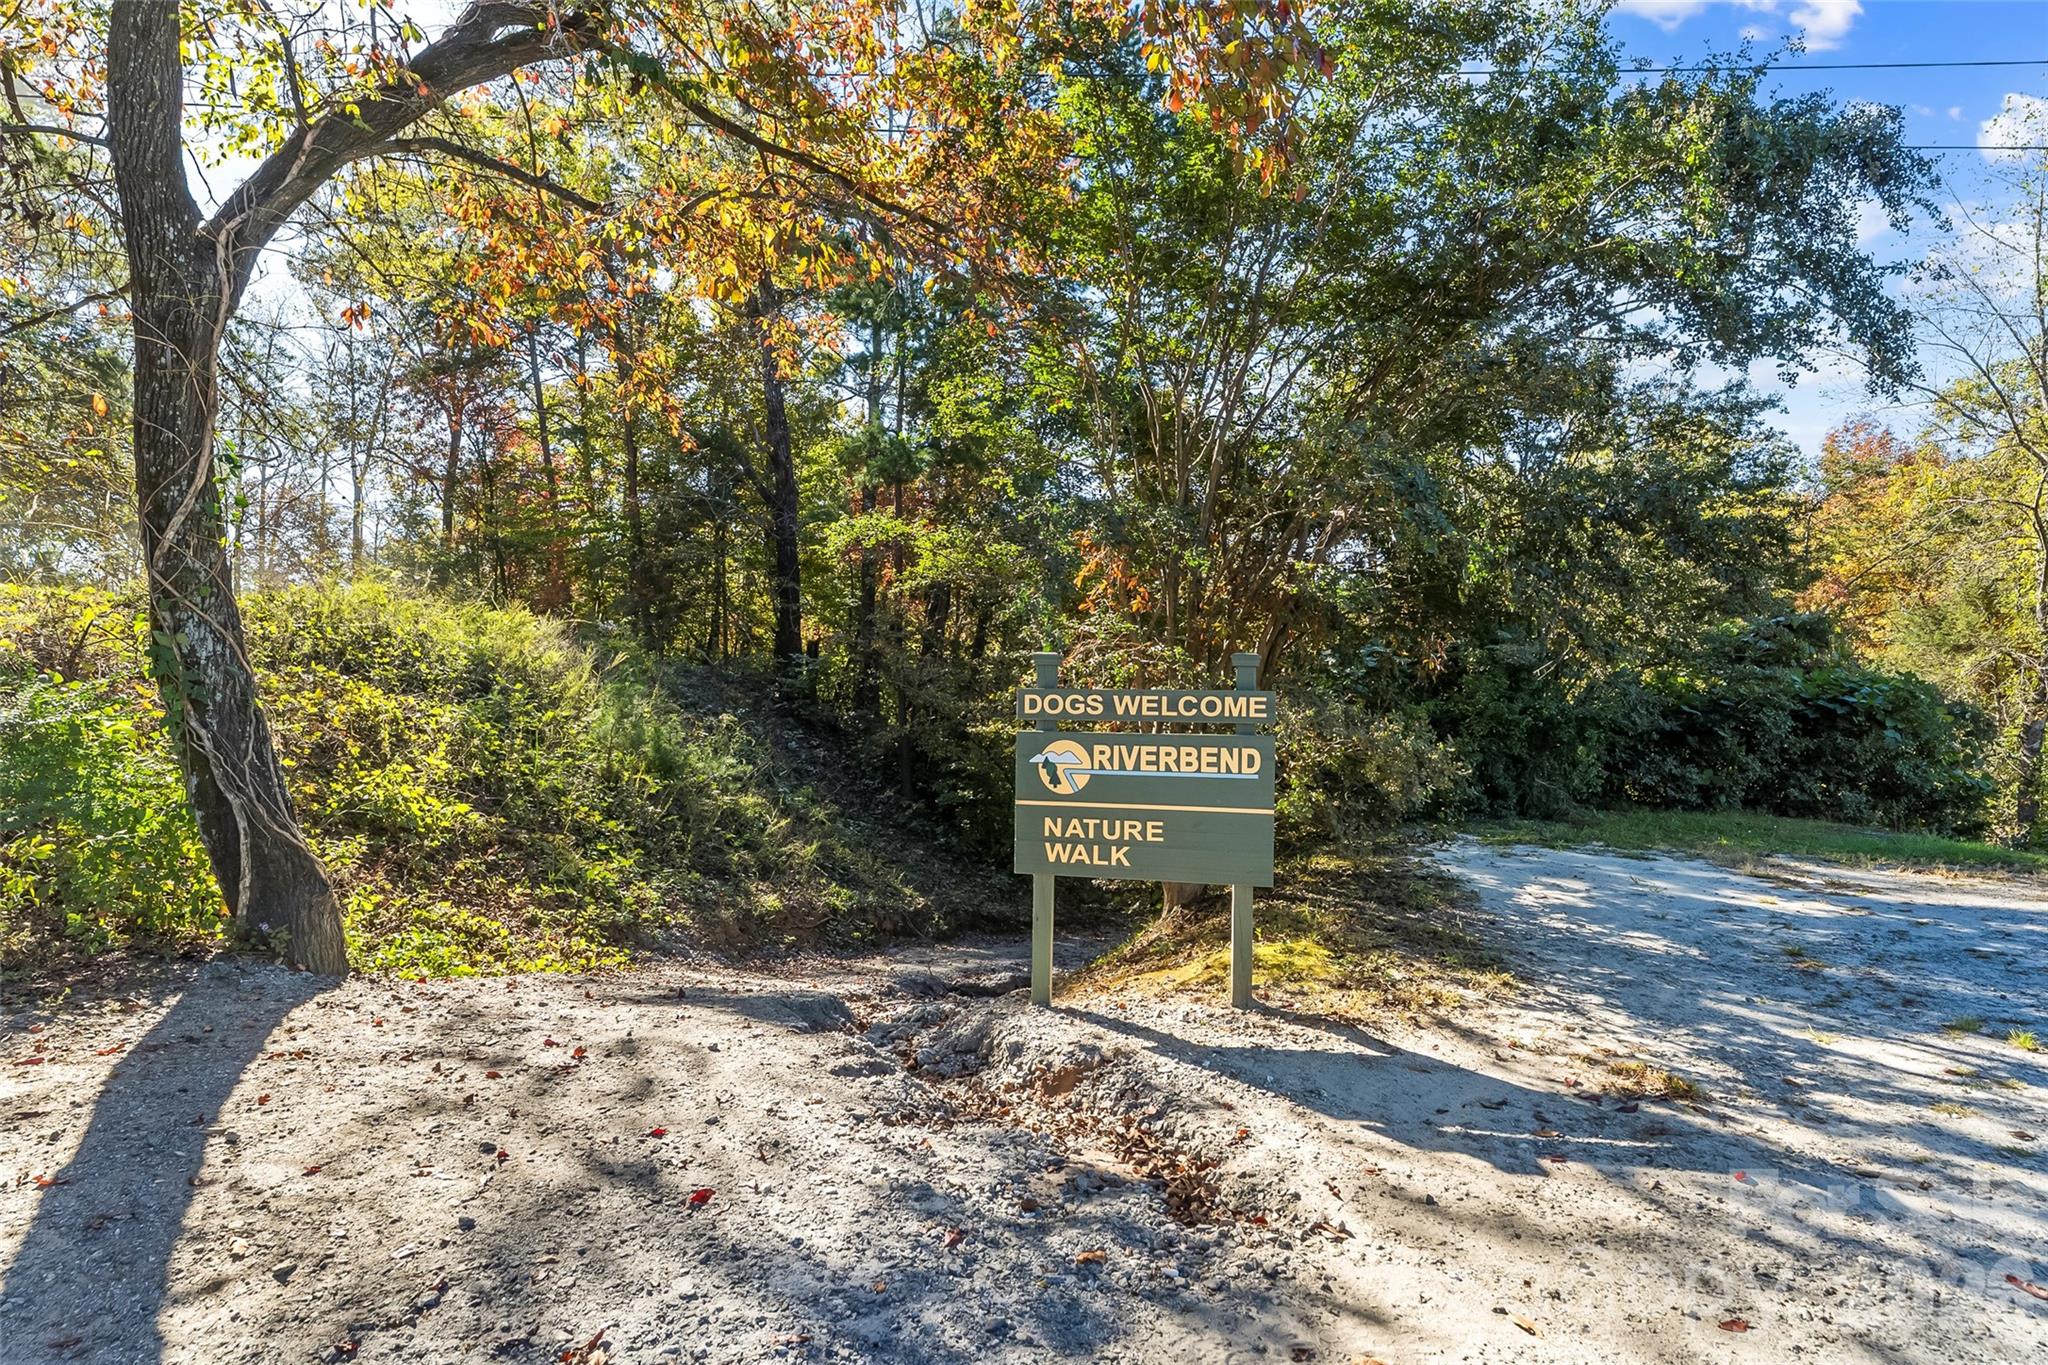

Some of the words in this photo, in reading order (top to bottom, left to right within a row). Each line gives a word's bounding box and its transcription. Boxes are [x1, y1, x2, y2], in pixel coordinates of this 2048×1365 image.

[1023, 694, 1104, 716] DOGS
[1112, 695, 1268, 718] WELCOME
[1093, 744, 1262, 774] RIVERBEND
[1043, 816, 1165, 842] NATURE
[1044, 842, 1132, 867] WALK
